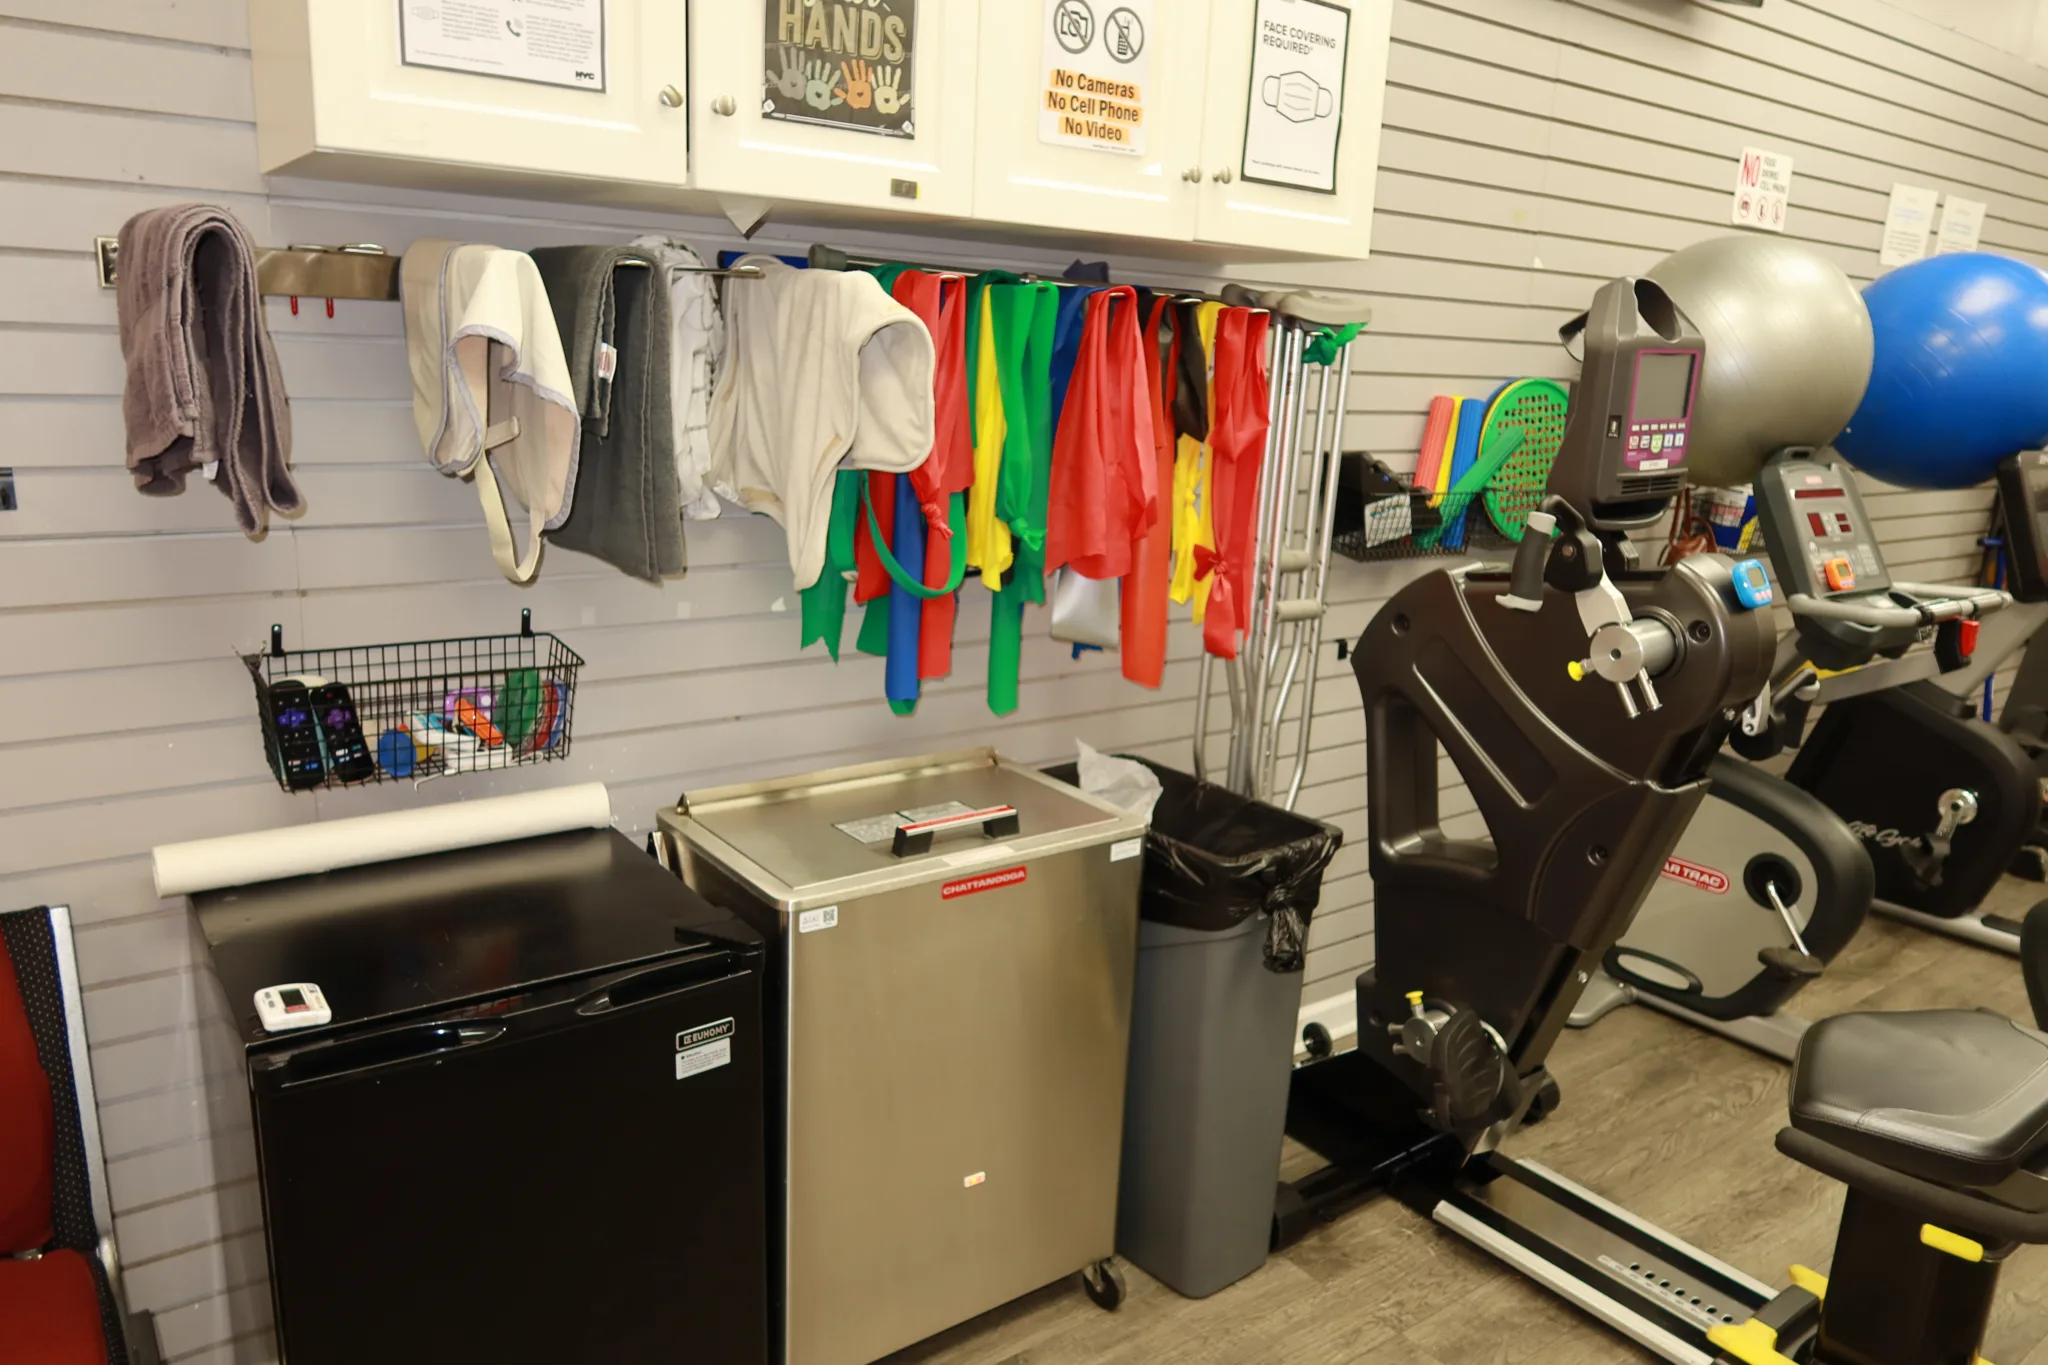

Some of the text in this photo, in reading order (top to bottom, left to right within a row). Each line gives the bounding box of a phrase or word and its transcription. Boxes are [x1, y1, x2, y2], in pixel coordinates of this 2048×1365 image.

[778, 0, 907, 64] HANDS
[1264, 20, 1336, 49] FACE COVERING
[575, 70, 595, 80] NYC
[1055, 69, 1135, 99] No Cameras
[1048, 91, 1139, 122] No Cell Phone
[1065, 117, 1122, 141] No Video
[1741, 152, 1761, 188] NO
[943, 871, 1026, 896] CHATTANOOGA
[1682, 867, 1722, 888] TRAC
[692, 1023, 730, 1042] EUHOMY
